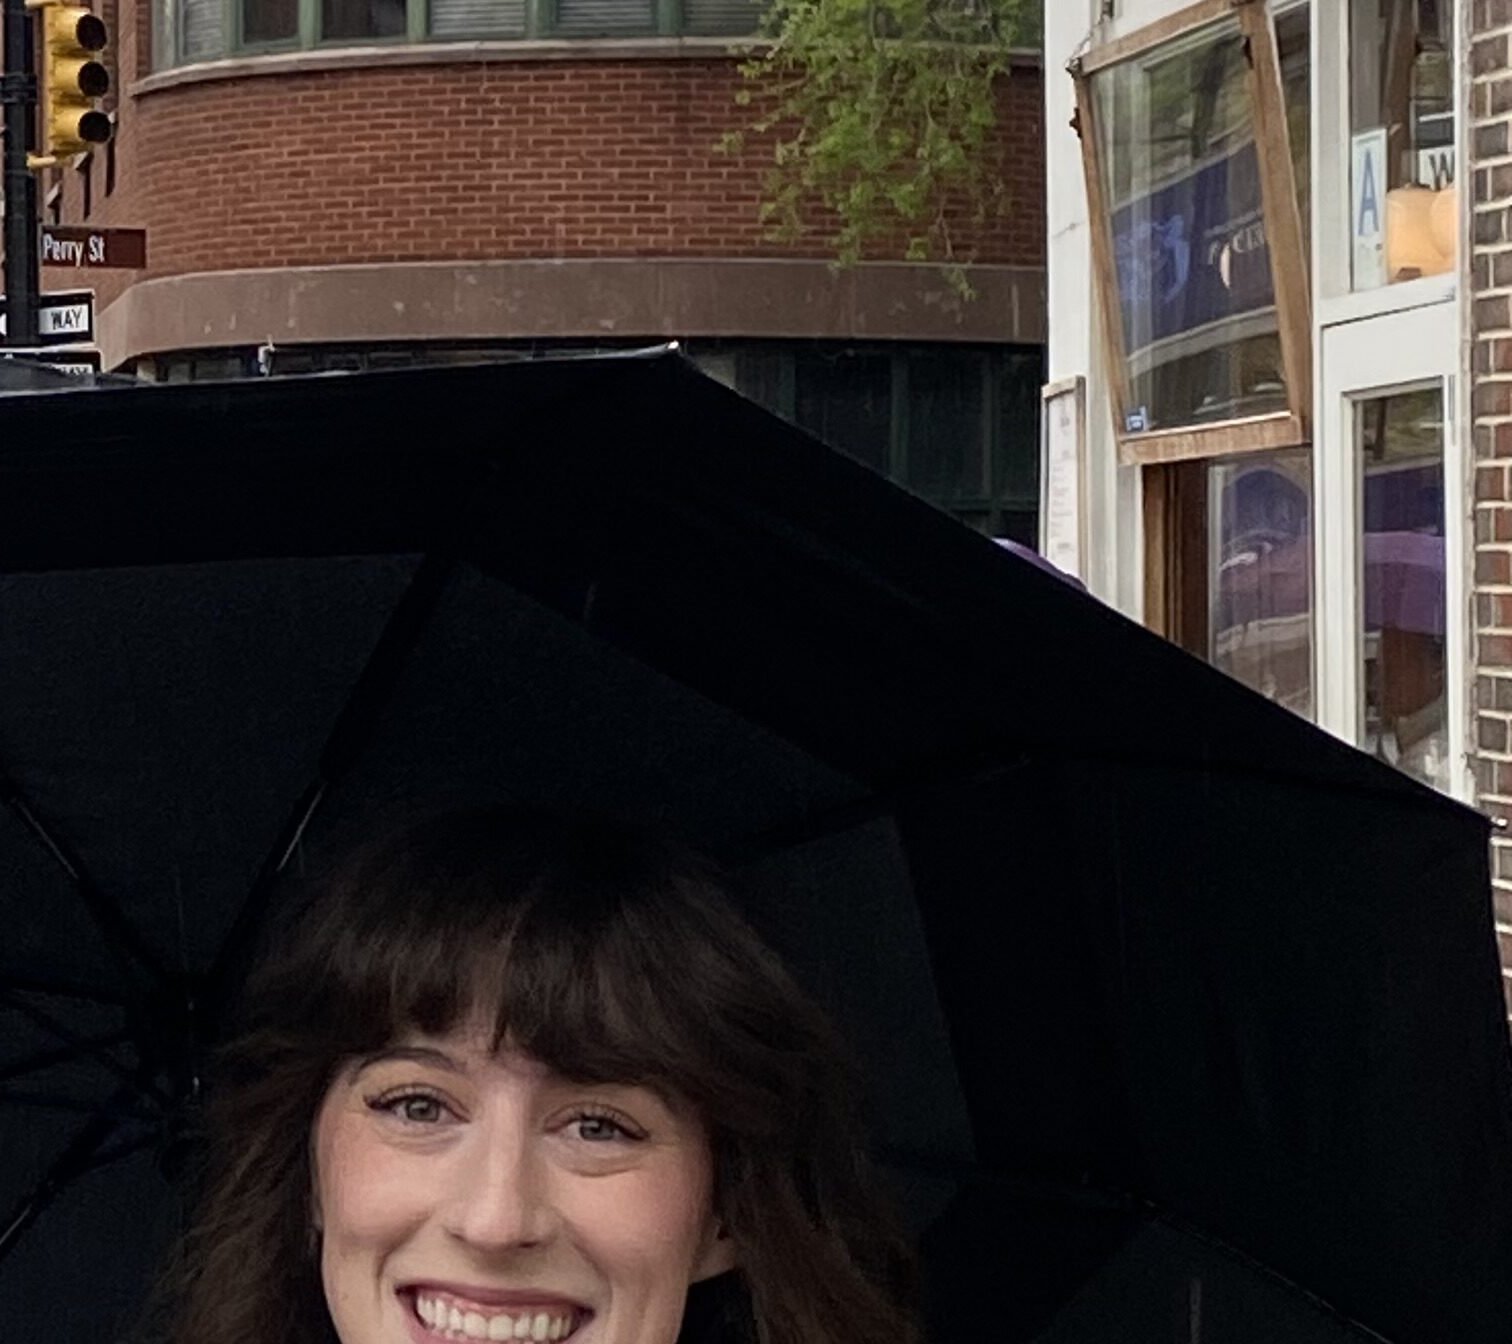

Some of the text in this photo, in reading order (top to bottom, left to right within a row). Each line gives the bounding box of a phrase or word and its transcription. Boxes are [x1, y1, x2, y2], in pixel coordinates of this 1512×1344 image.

[42, 233, 105, 267] Perry St
[50, 307, 83, 330] WAY
